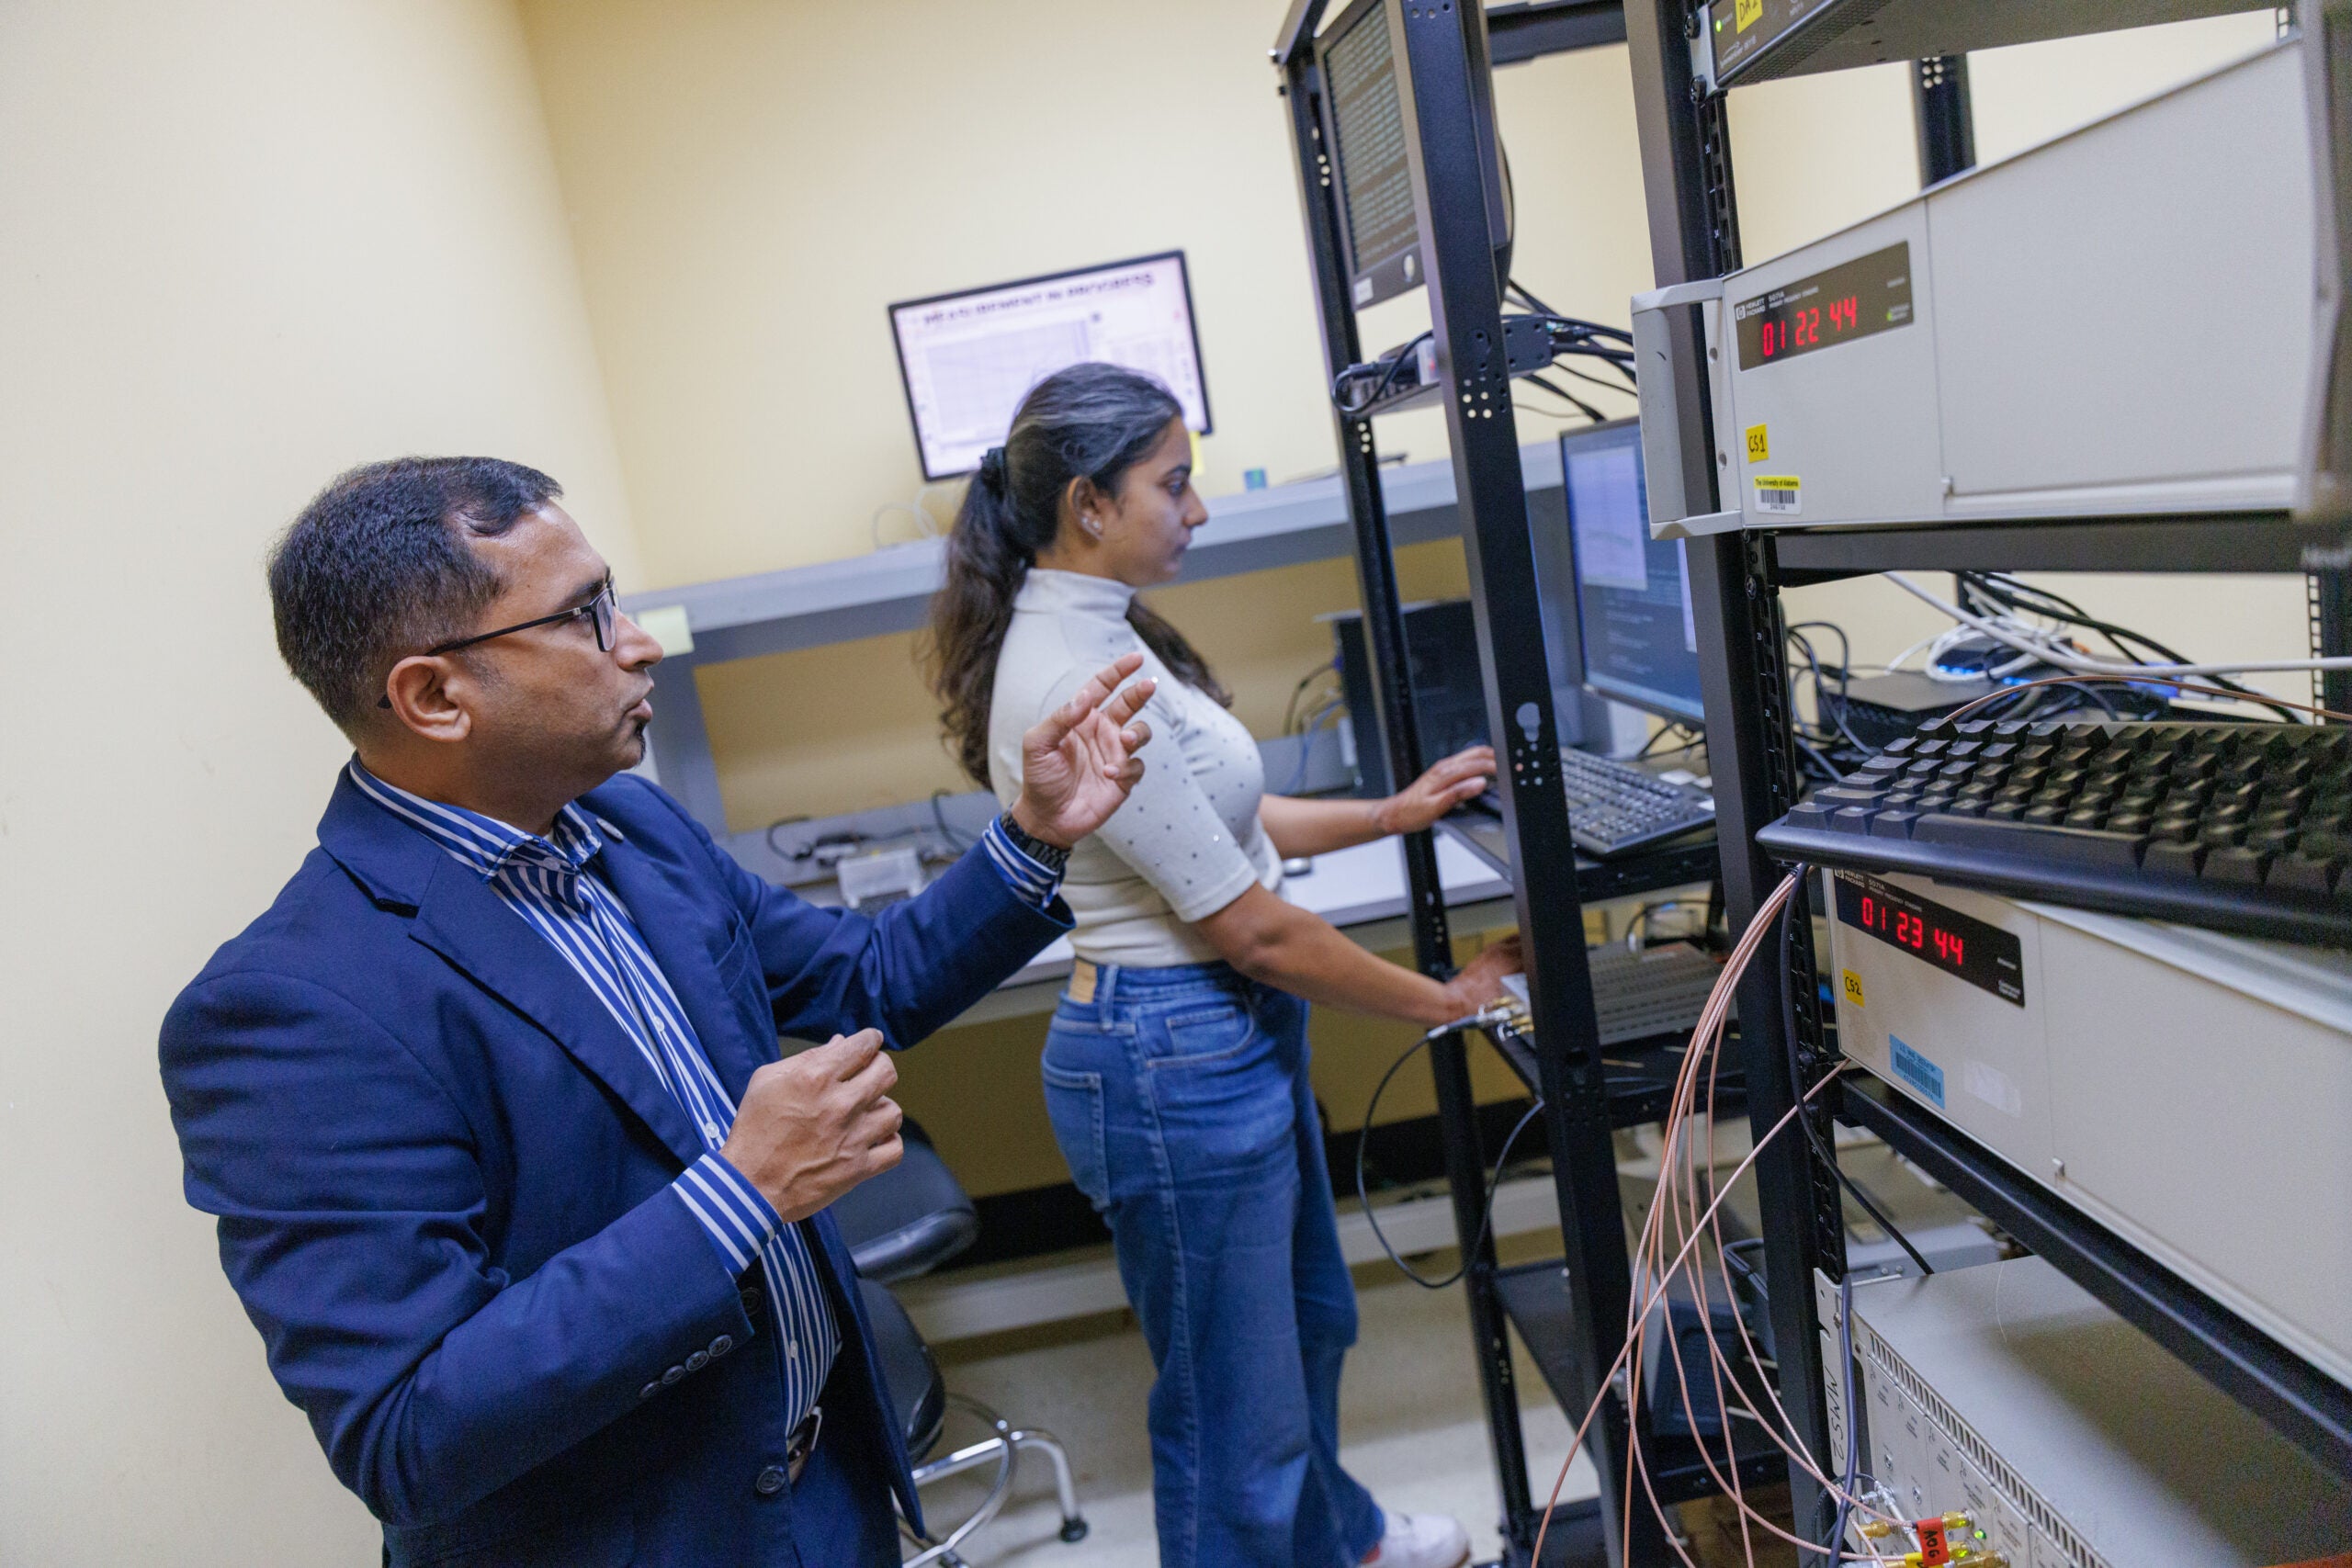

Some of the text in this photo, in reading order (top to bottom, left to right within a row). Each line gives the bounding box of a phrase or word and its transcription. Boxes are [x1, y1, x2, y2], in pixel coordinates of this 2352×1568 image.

[1746, 298, 1765, 309] HEWLETT
[1762, 320, 1787, 357] 01
[1795, 307, 1820, 346] 22
[1829, 295, 1858, 332] 44
[1748, 434, 1767, 453] CS1
[1845, 876, 1865, 888] PACKARD
[1868, 879, 1885, 890] 5071A
[1861, 897, 1963, 966] 01 23 44
[1845, 976, 1862, 996] CS2
